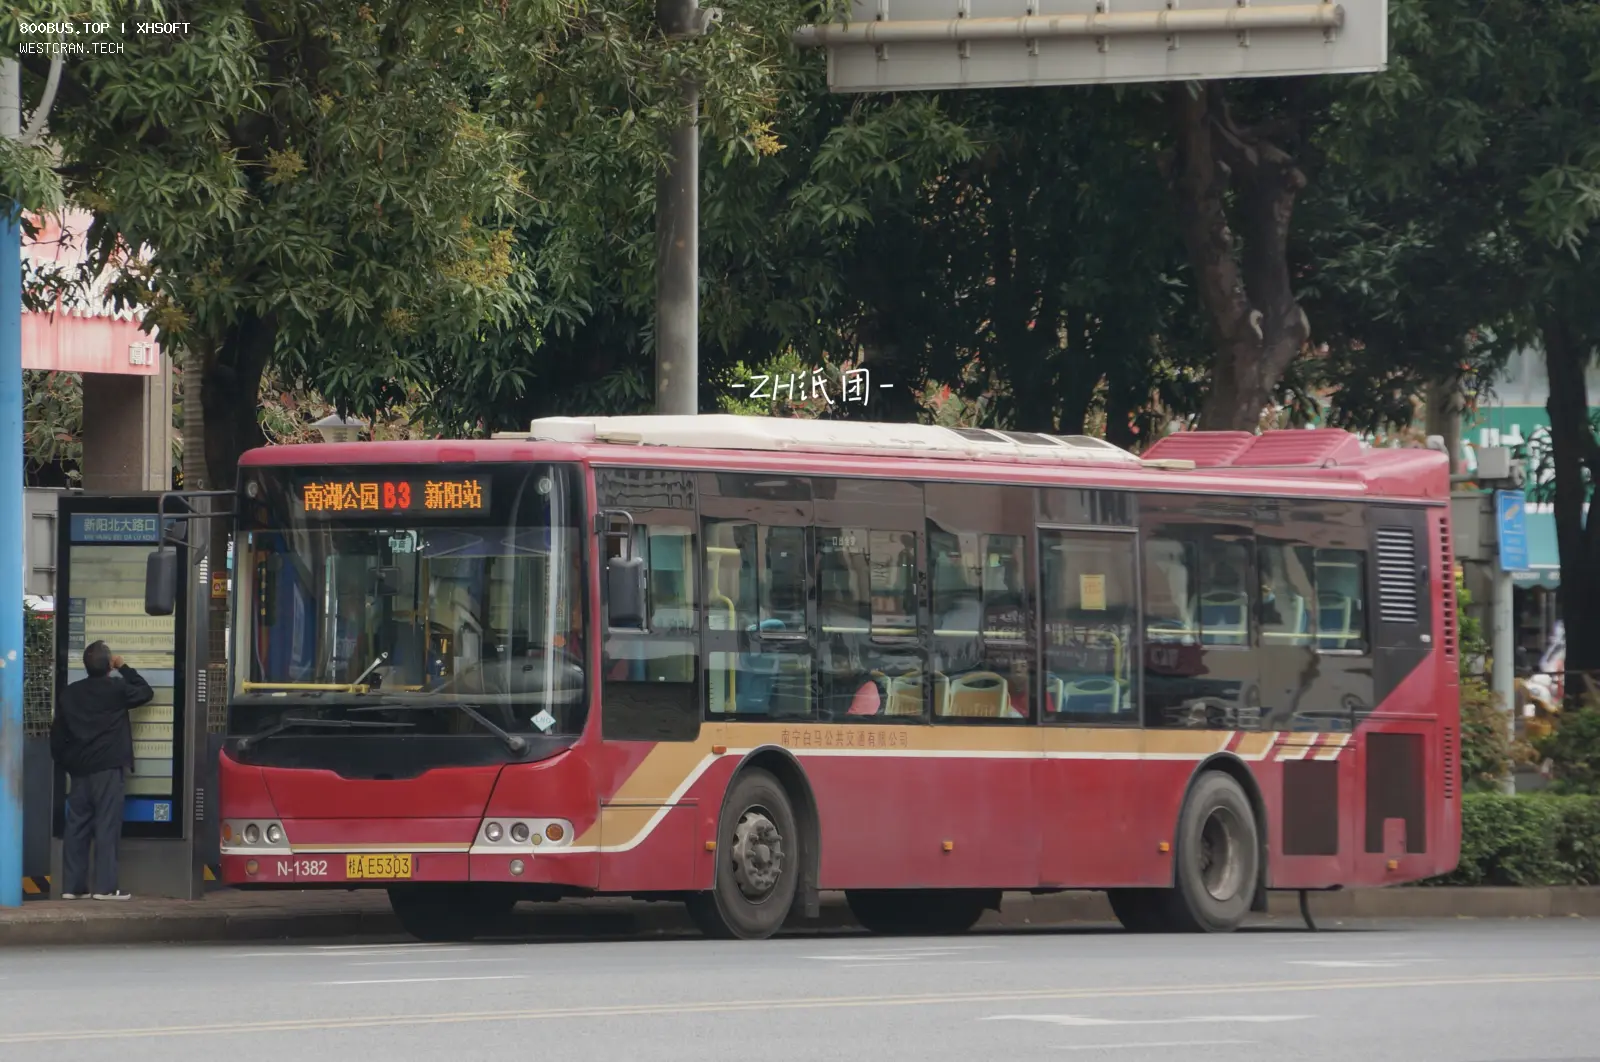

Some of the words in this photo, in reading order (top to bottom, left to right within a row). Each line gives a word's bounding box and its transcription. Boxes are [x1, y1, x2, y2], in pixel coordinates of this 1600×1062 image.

[303, 481, 379, 511] 南湖公园
[383, 481, 411, 509] B3
[424, 479, 482, 509] 新阳站
[84, 518, 155, 532] 新阳北大路口
[781, 728, 908, 748] 南宁白马公共交通有限公司
[277, 860, 327, 876] N-1382
